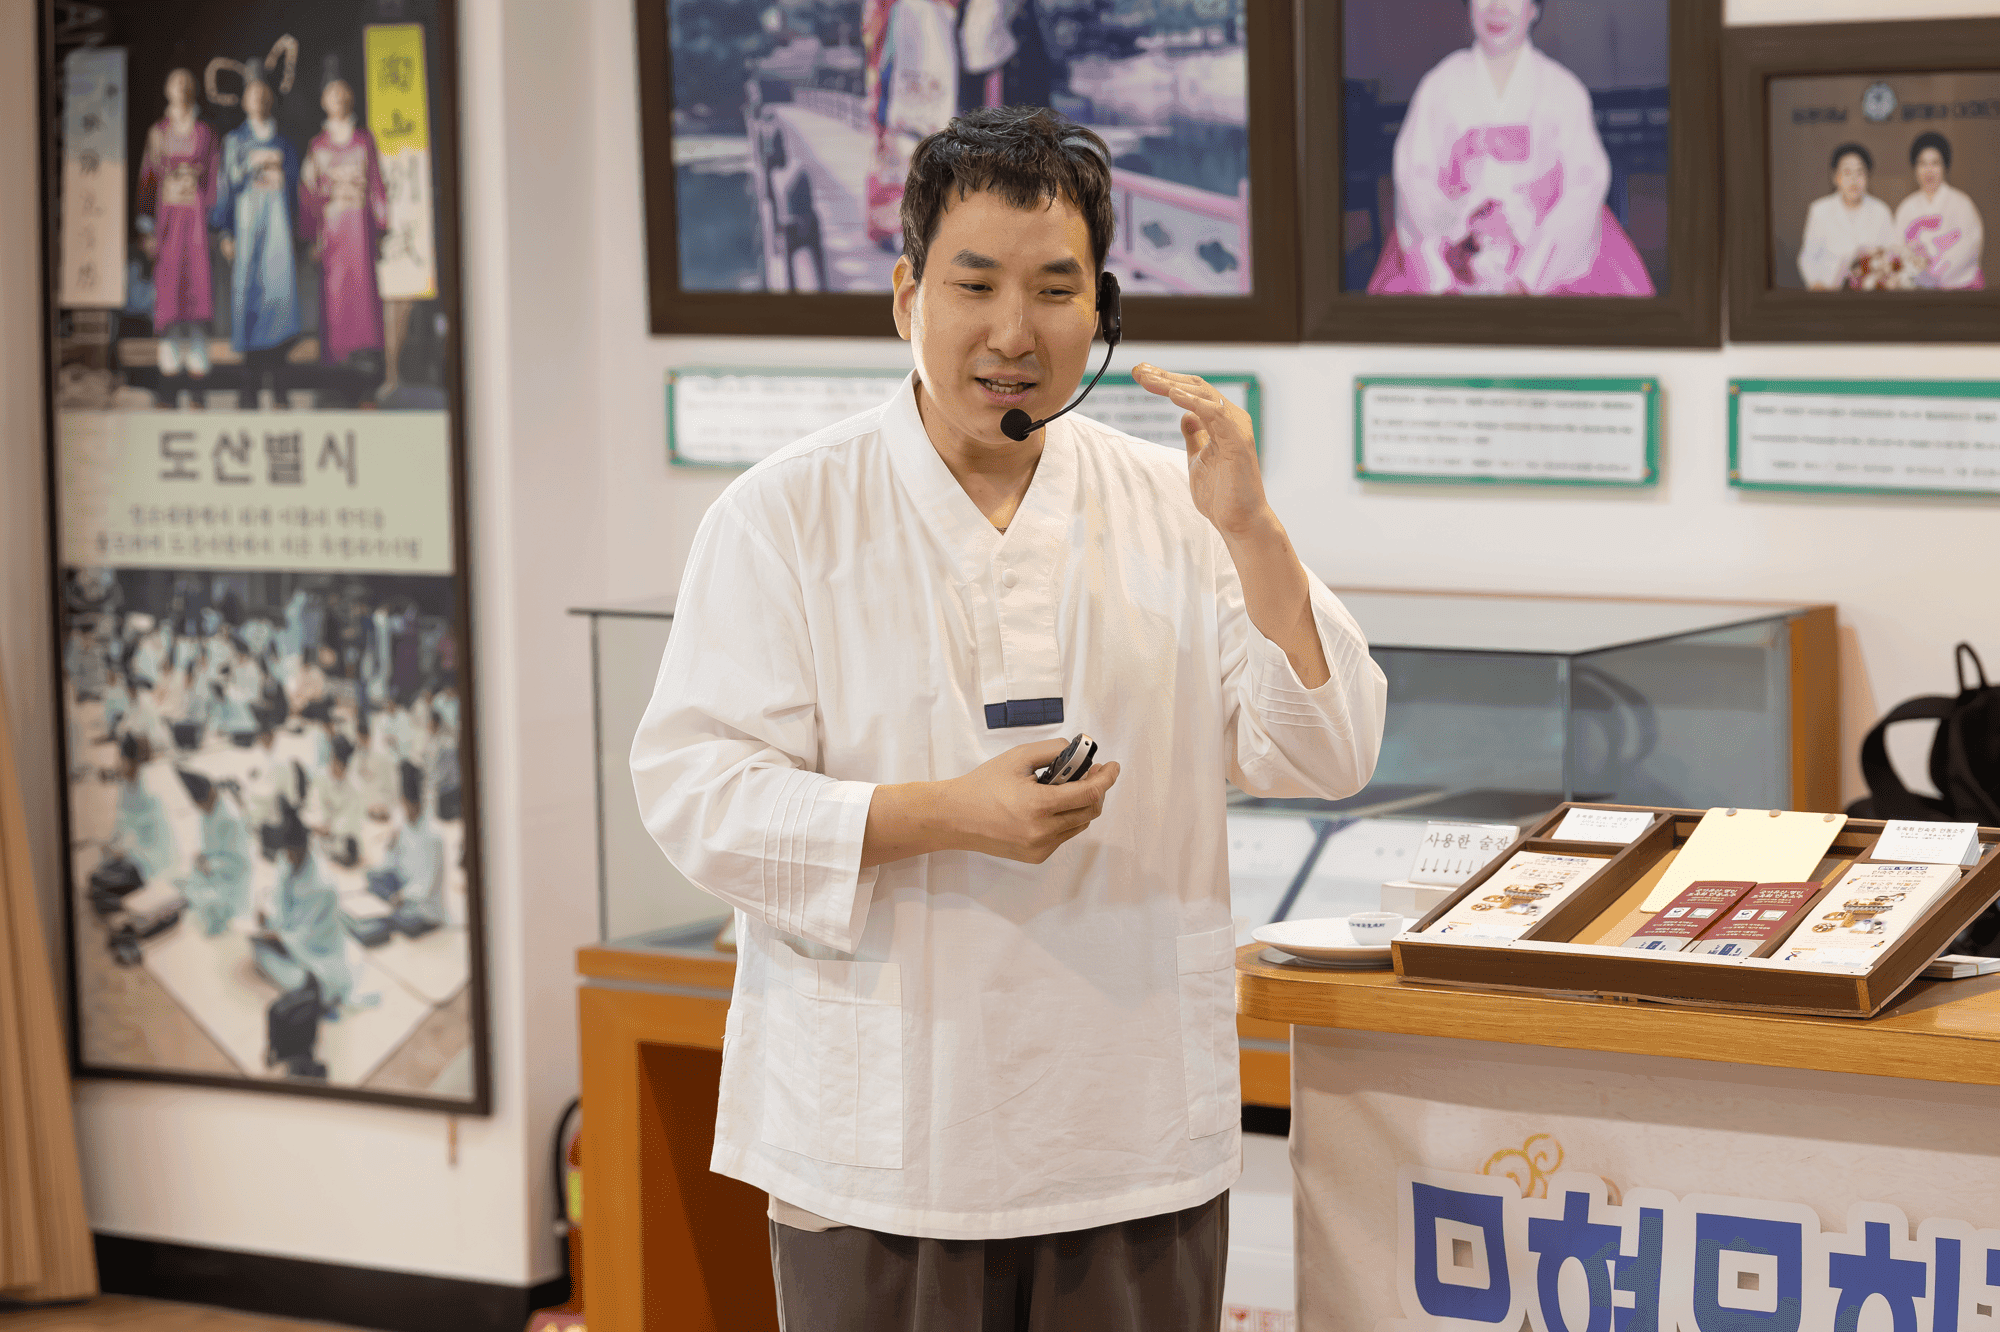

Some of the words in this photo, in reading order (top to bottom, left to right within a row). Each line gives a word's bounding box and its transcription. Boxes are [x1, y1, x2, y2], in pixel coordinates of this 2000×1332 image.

[160, 430, 358, 486] 도산별시
[1425, 832, 1471, 849] 사용한
[1479, 835, 1510, 851] 술잔
